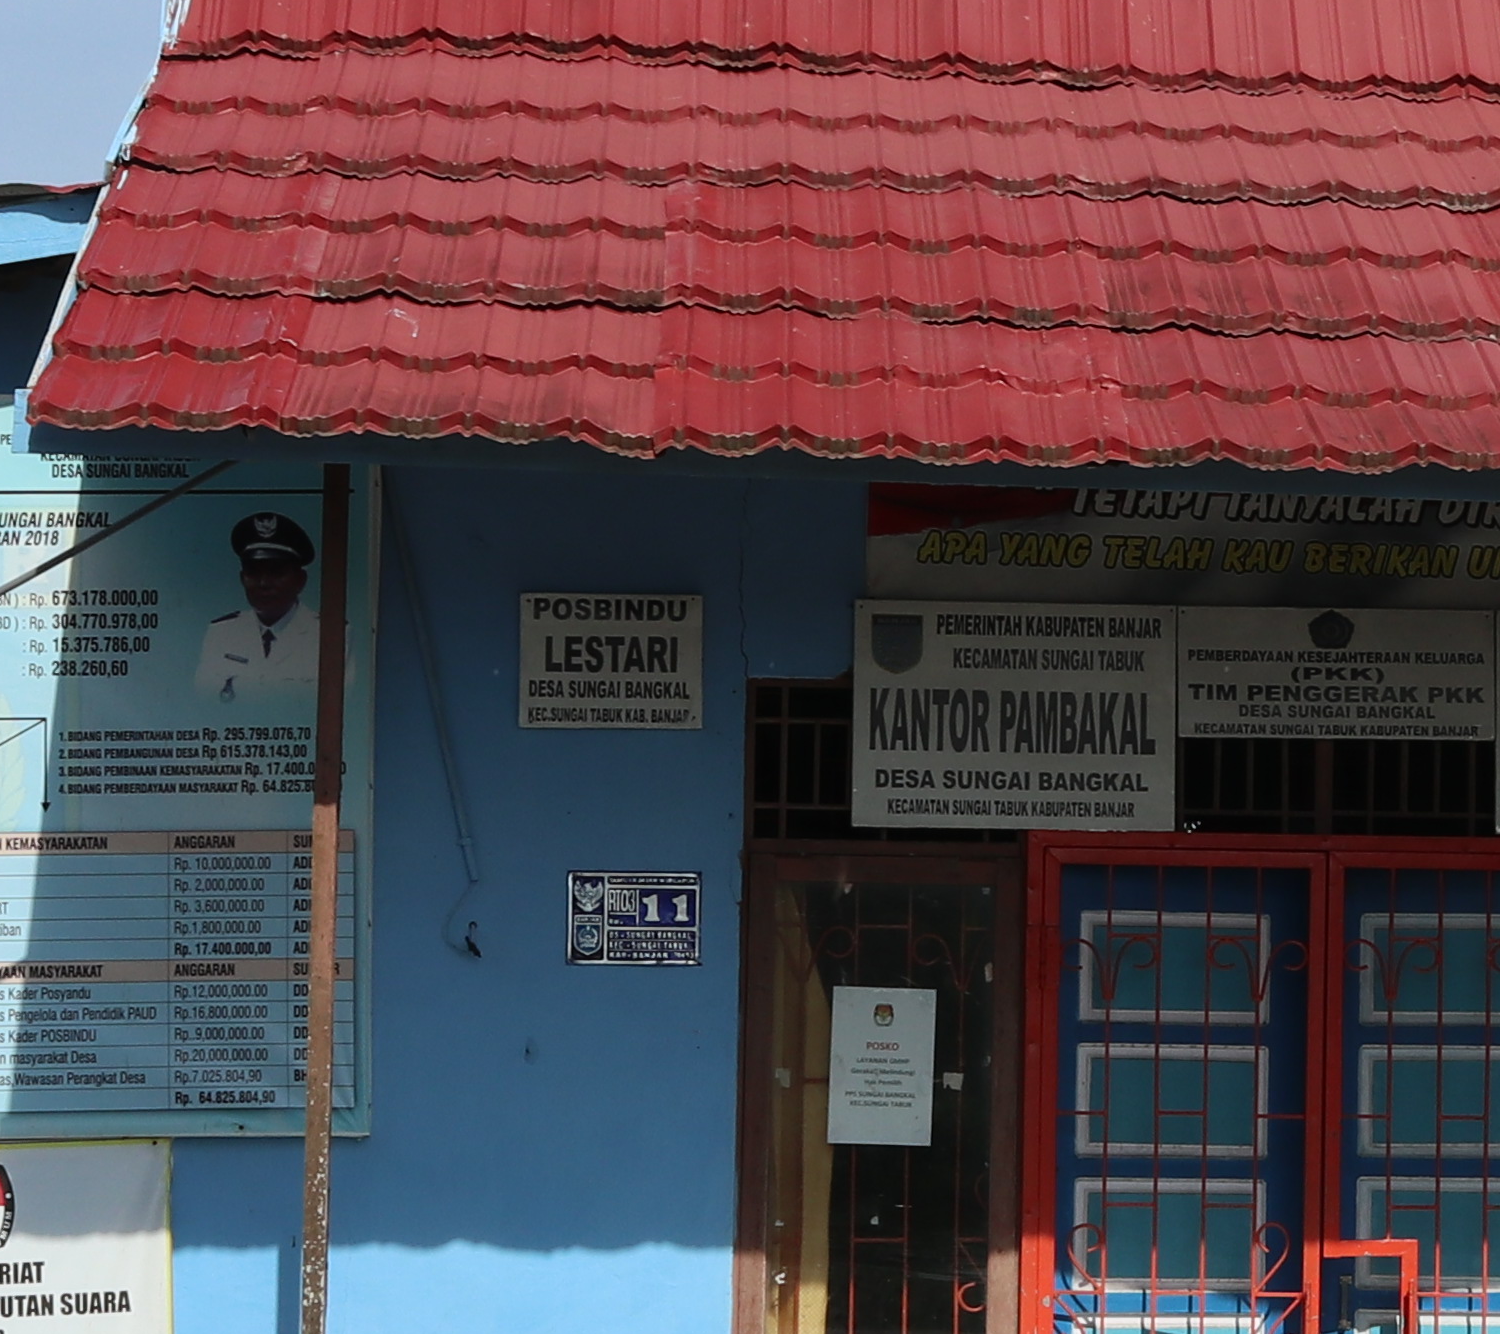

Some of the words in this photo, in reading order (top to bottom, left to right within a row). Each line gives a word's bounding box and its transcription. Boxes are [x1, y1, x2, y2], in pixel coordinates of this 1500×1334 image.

[52, 464, 82, 478] DESA
[86, 464, 131, 478] SUNGAI
[134, 463, 189, 478] BANGKAL
[1072, 488, 1209, 520] TETAPI
[1225, 490, 1423, 529] TANYALAH
[46, 512, 112, 527] BANGKAL
[24, 531, 59, 546] 2018
[917, 529, 988, 565] APA
[1000, 532, 1092, 568] YANG
[1103, 536, 1214, 571] TELAH
[1222, 539, 1295, 574] KAU
[1303, 539, 1460, 578] BERIKAN
[52, 591, 158, 607] 673.178.000,00
[533, 597, 687, 622] POSBINDU
[52, 614, 158, 631] 304.770.978,00
[937, 614, 1022, 636] PEMERINTAH
[1026, 616, 1104, 637] KABUPATEN
[1109, 617, 1161, 639] BANJAR
[52, 637, 150, 653] 15.375.786,00
[545, 636, 678, 673] LESTARI
[953, 648, 1038, 670] KECAMATAN
[1041, 649, 1094, 671] SUNGAI
[1098, 650, 1144, 671] TABUK
[1188, 649, 1293, 662] PEMBERDAYAAN
[1298, 650, 1410, 664] KESEJAHTERAAN
[1415, 651, 1484, 665] KELUARGA
[52, 661, 128, 678] 238.260,60
[1291, 667, 1384, 684] (PKK)
[529, 679, 566, 698] DESA
[569, 679, 621, 699] SUNGAI
[625, 680, 690, 700] BANGKAL
[1188, 684, 1237, 701] TIM
[1248, 685, 1418, 703] PENGGERAK
[1428, 687, 1484, 704] PKK
[591, 708, 623, 724] TABUK
[625, 708, 649, 724] KAB.
[869, 687, 990, 753] KANTOR
[999, 690, 1156, 755] PAMBAKAL
[224, 727, 311, 741] 295.799.076,70
[220, 745, 307, 759] 615.378.143,00
[875, 769, 935, 788] DESA
[942, 770, 1030, 790] SUNGAI
[1038, 772, 1149, 792] BANGKAL
[6, 837, 108, 850] KEMASYARAKATAN
[174, 836, 235, 849] ANGGARAN
[866, 1042, 899, 1050] POSKO
[60, 1291, 131, 1315] SUARA
